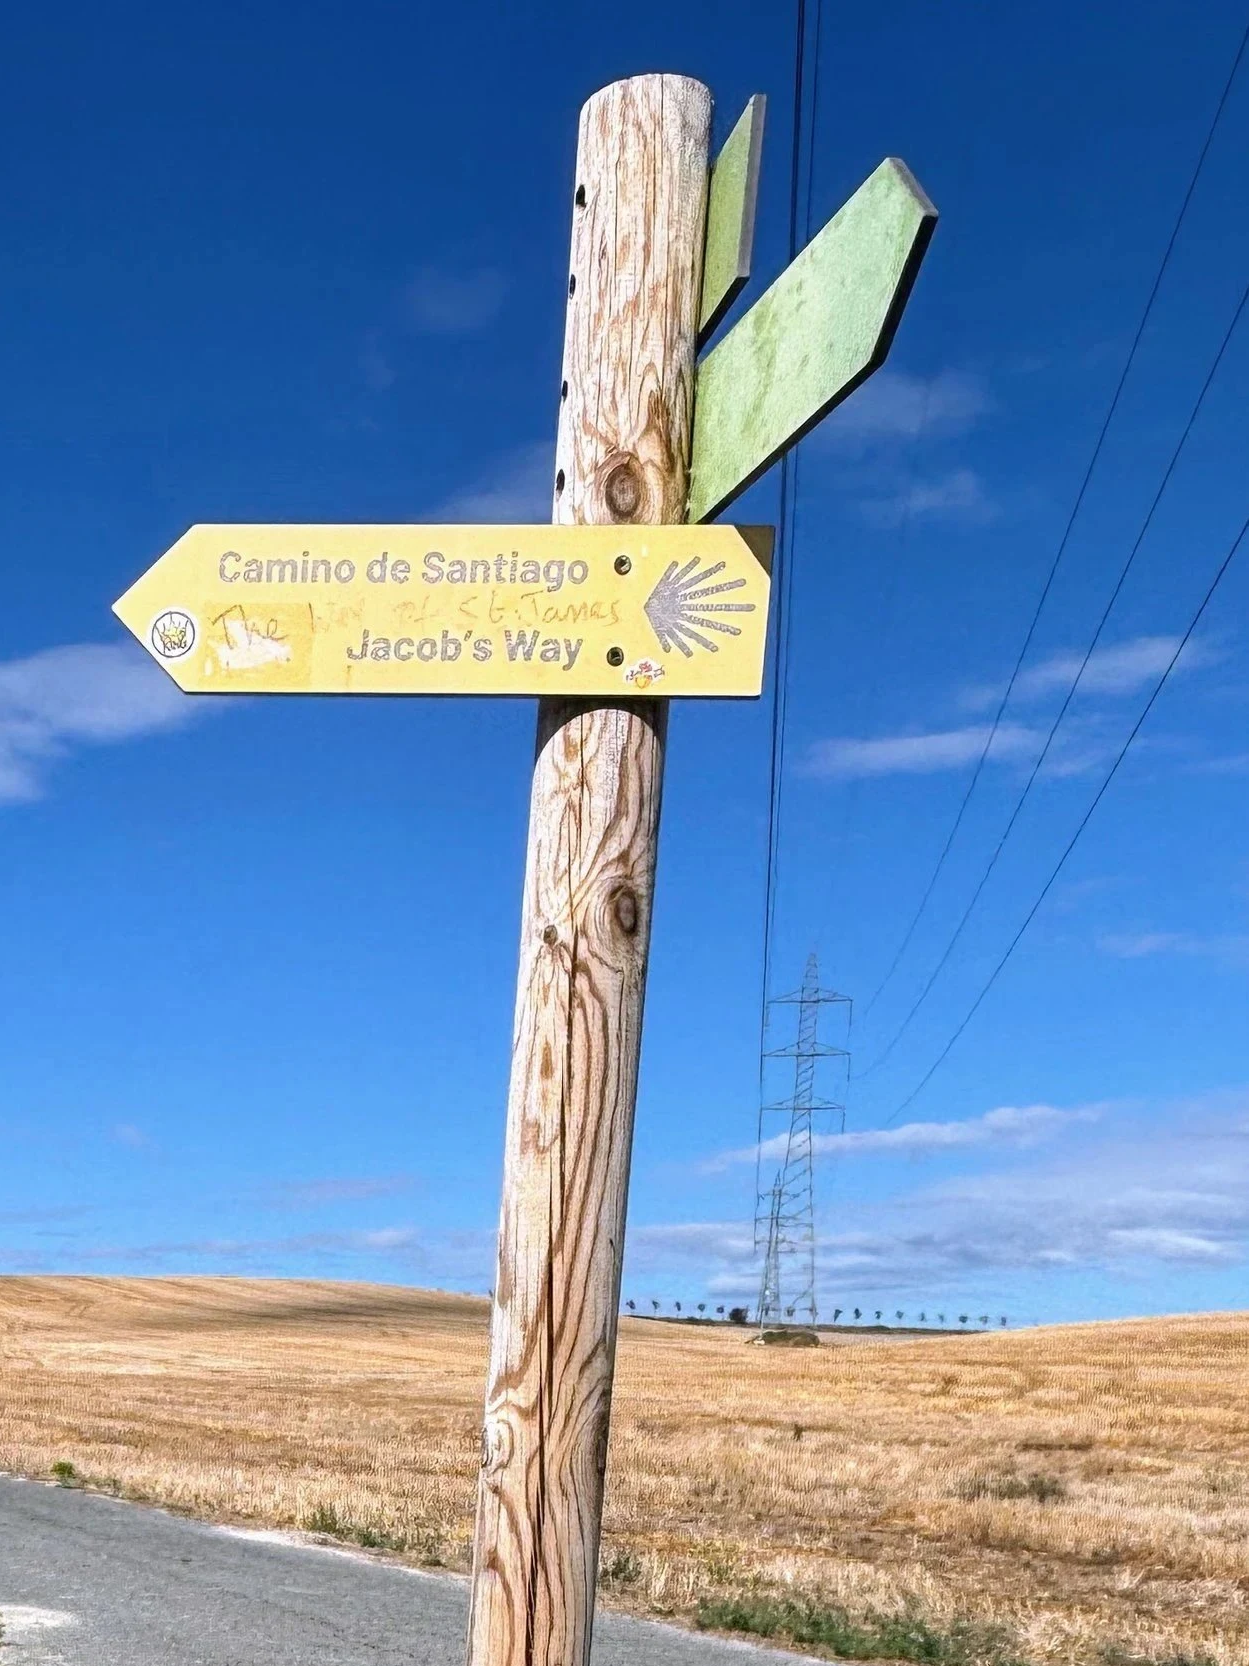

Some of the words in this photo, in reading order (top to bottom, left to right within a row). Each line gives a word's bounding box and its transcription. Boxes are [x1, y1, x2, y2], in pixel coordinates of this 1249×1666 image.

[219, 551, 356, 584] Camino
[366, 551, 411, 584] de
[421, 551, 589, 592] Santiago
[346, 628, 493, 662] Jacob's
[504, 629, 584, 672] Way
